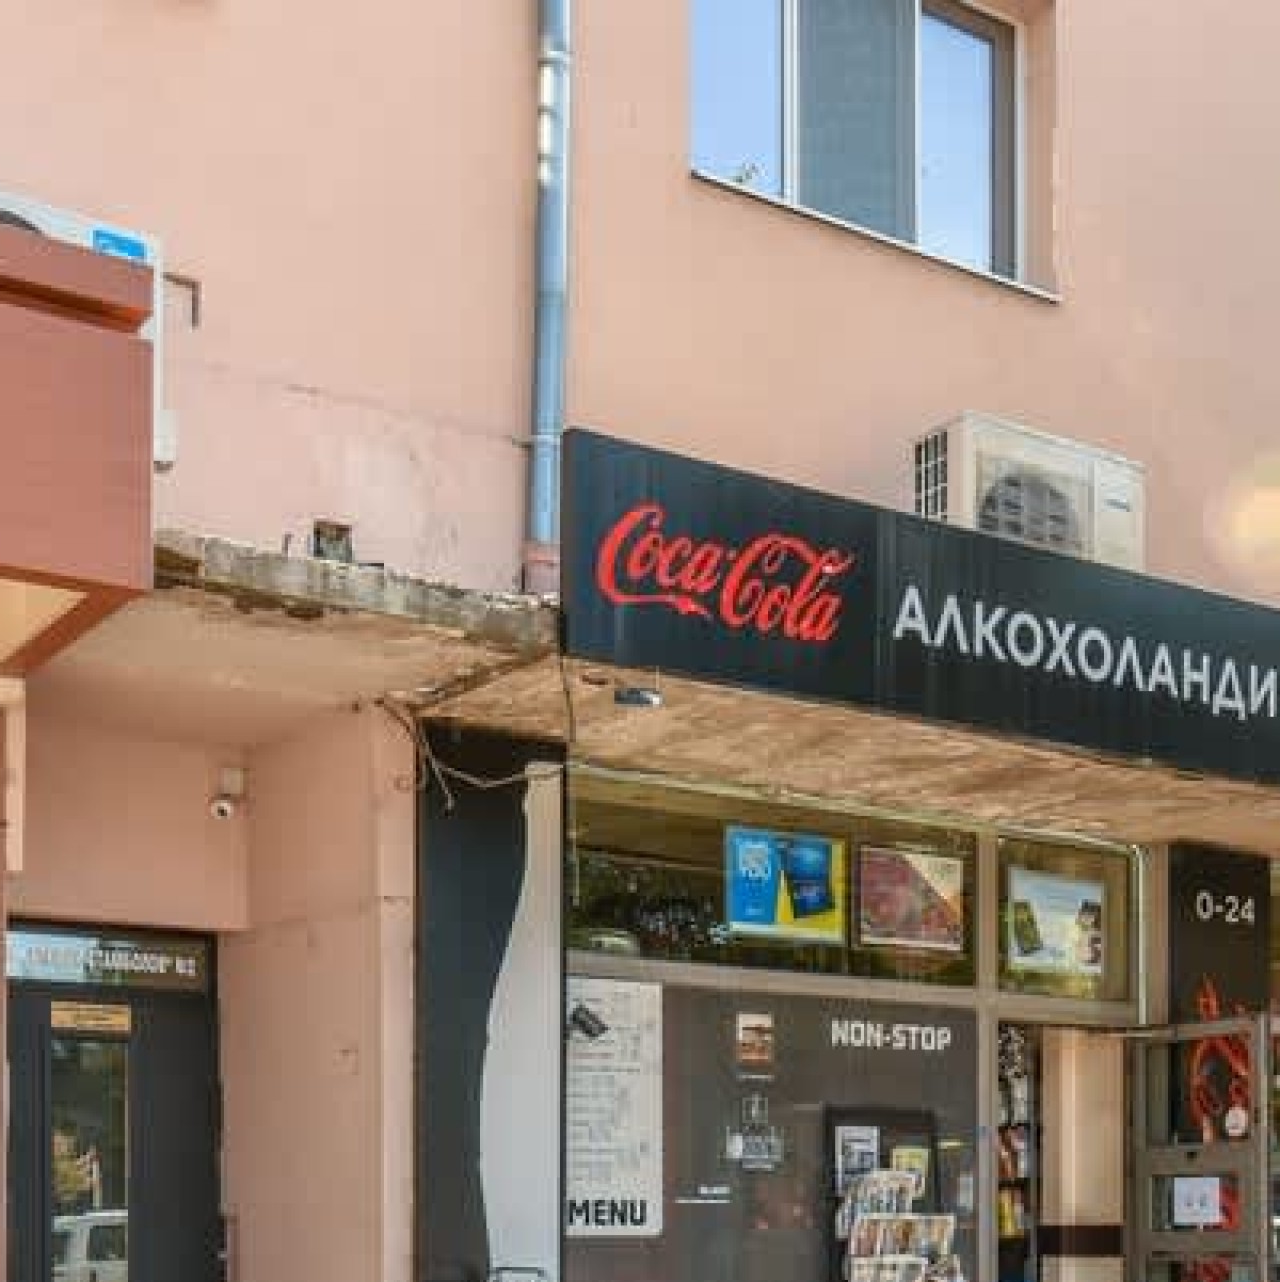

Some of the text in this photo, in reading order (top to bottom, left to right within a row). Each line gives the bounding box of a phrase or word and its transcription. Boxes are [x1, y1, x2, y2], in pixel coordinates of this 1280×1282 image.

[596, 501, 854, 644] Coca-Cola
[1196, 890, 1255, 926] 0-24
[831, 1018, 951, 1051] NON-STOP
[569, 1199, 648, 1226] MENU
